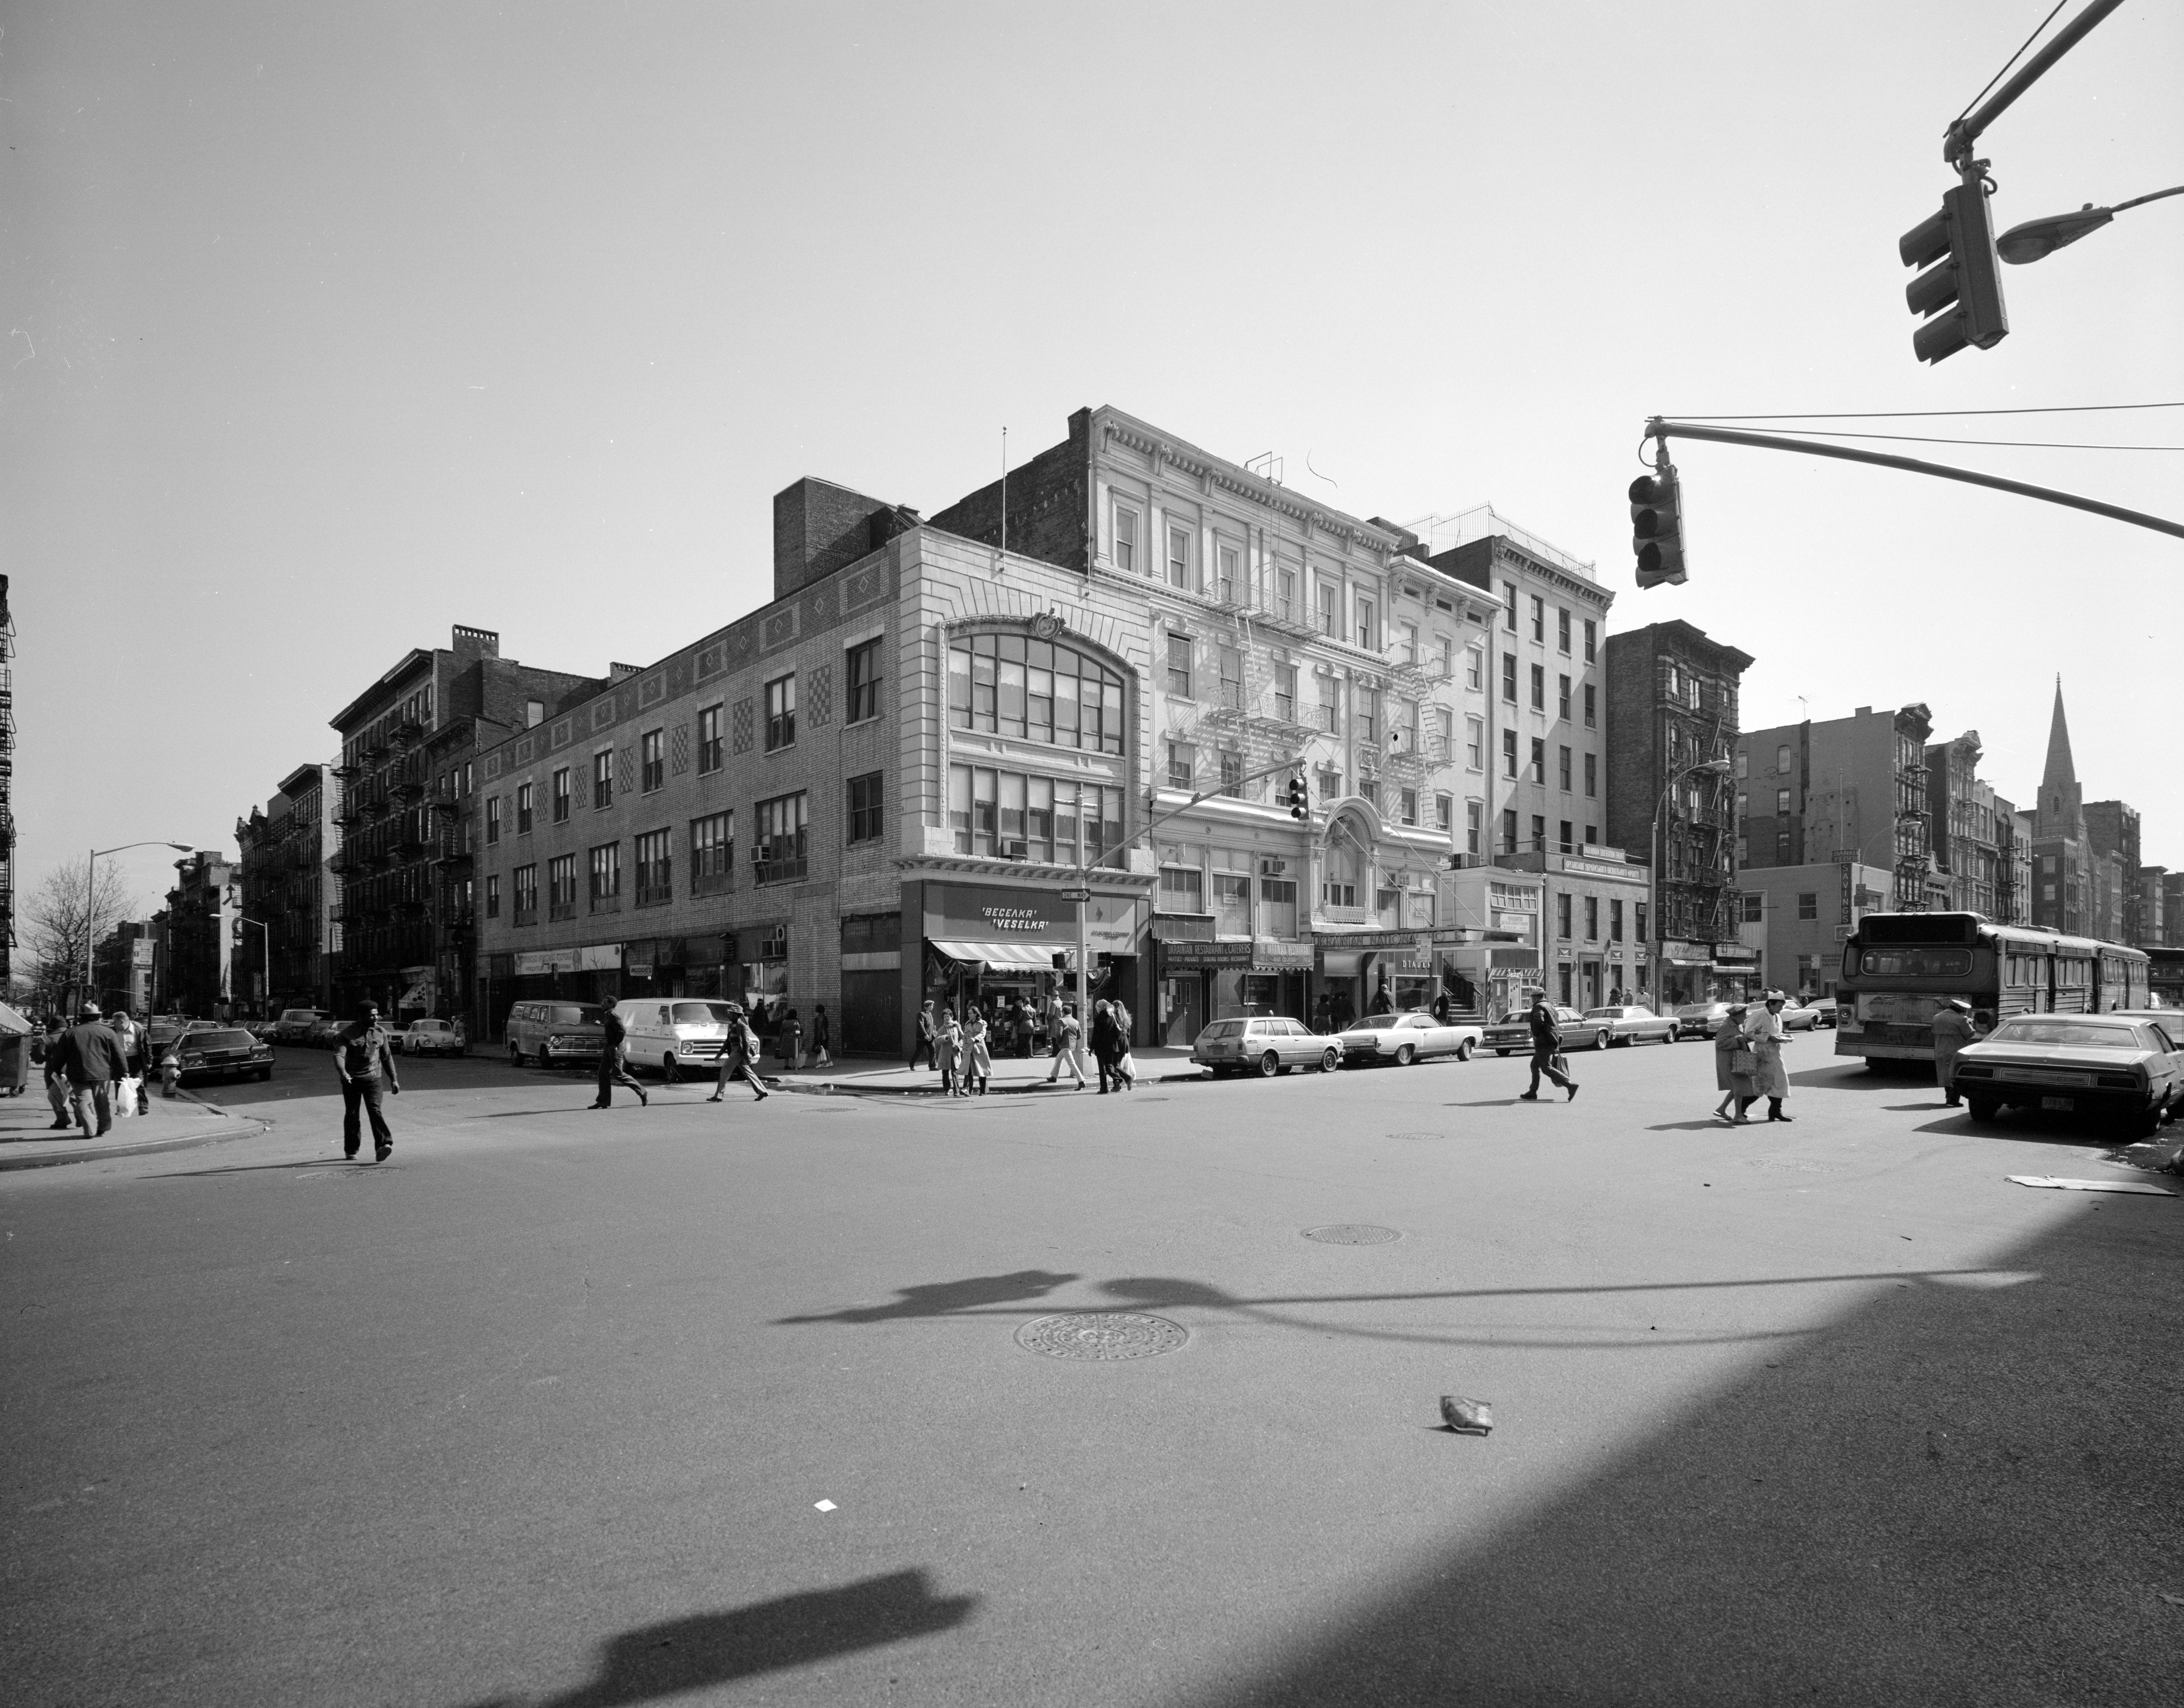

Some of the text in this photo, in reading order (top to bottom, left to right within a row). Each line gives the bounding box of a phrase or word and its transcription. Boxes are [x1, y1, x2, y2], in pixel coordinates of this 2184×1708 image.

[1314, 935, 1363, 946] UKRAINIAN
[1428, 930, 1460, 942] HOE
[1168, 945, 1192, 954] UKRAINIAN
[1194, 945, 1224, 954] RESTAURANT
[1228, 944, 1251, 953] CATERERS
[1268, 944, 1287, 955] UKRAINIAN
[1288, 945, 1310, 956] RESTAURANT
